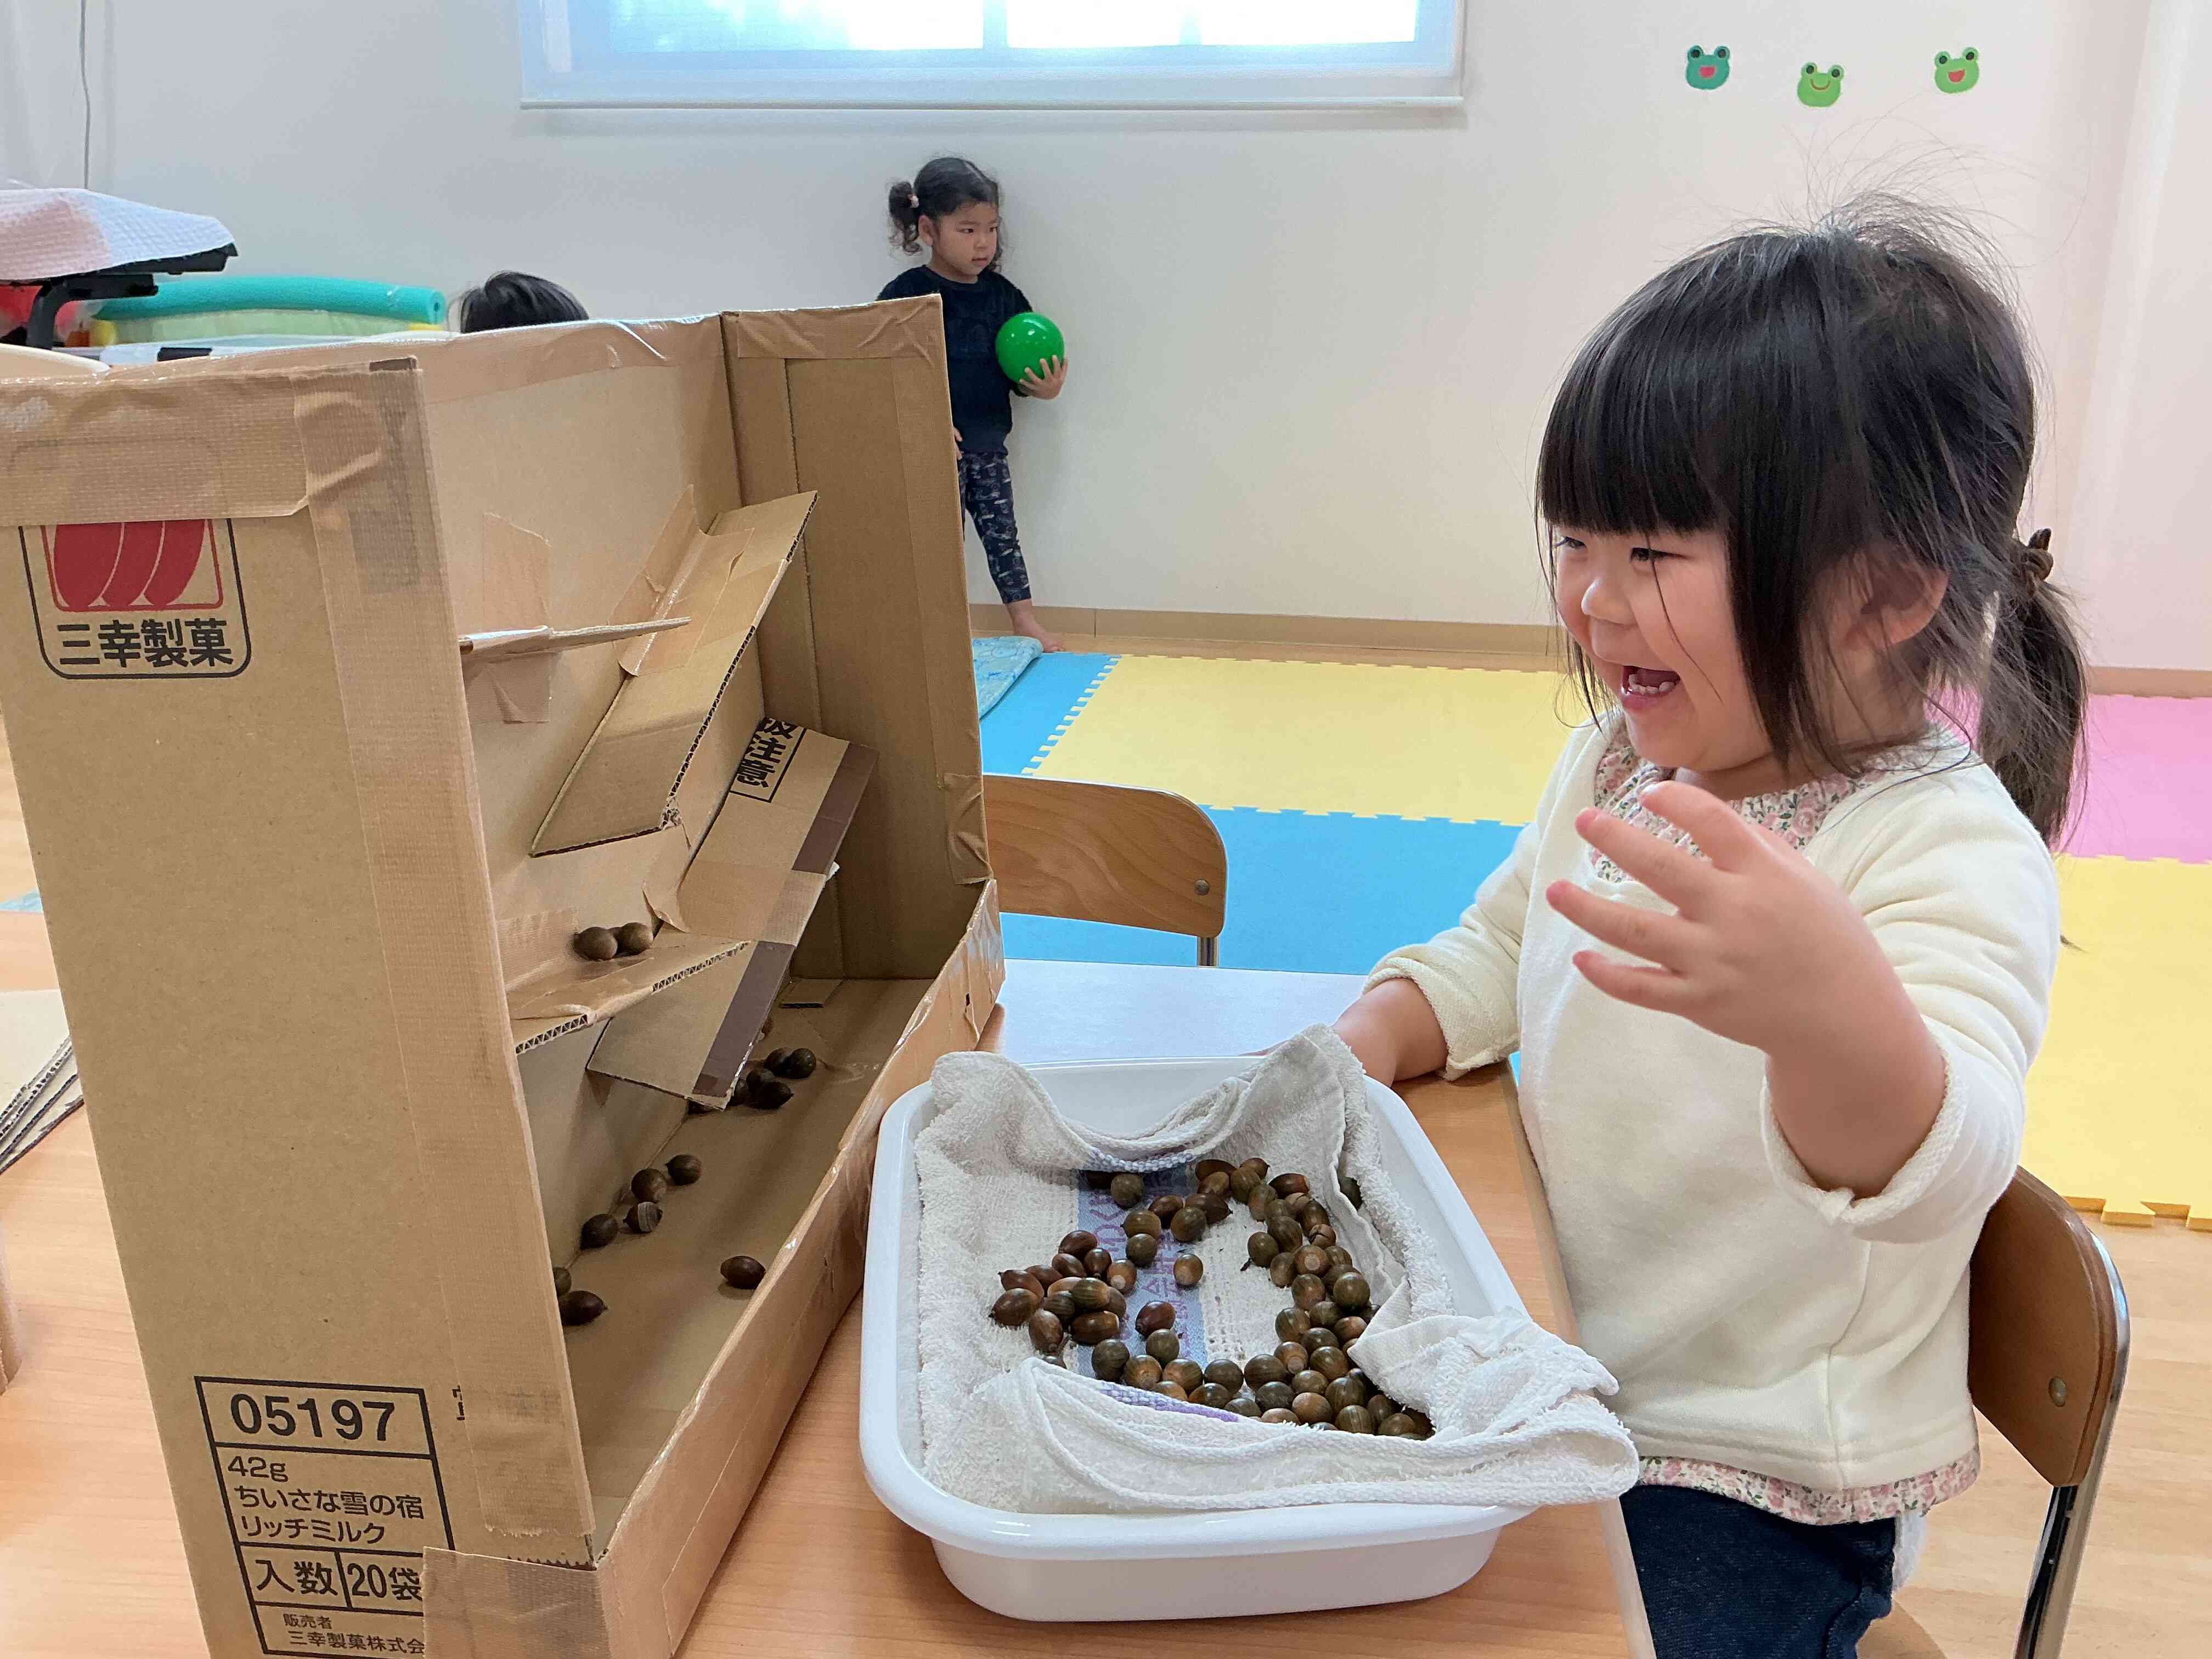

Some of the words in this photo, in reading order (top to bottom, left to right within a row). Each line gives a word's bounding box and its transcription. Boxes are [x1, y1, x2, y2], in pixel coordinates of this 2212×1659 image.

[57, 618, 234, 668] 三幸製菓
[230, 1393, 395, 1441] 05197
[227, 1455, 289, 1482] 42g
[234, 1485, 425, 1519] ちいさな雪の宿
[240, 1515, 385, 1544] リッチミルク
[255, 1559, 338, 1596] 入数
[347, 1563, 422, 1601] 20袋
[283, 1613, 332, 1629] 販売者
